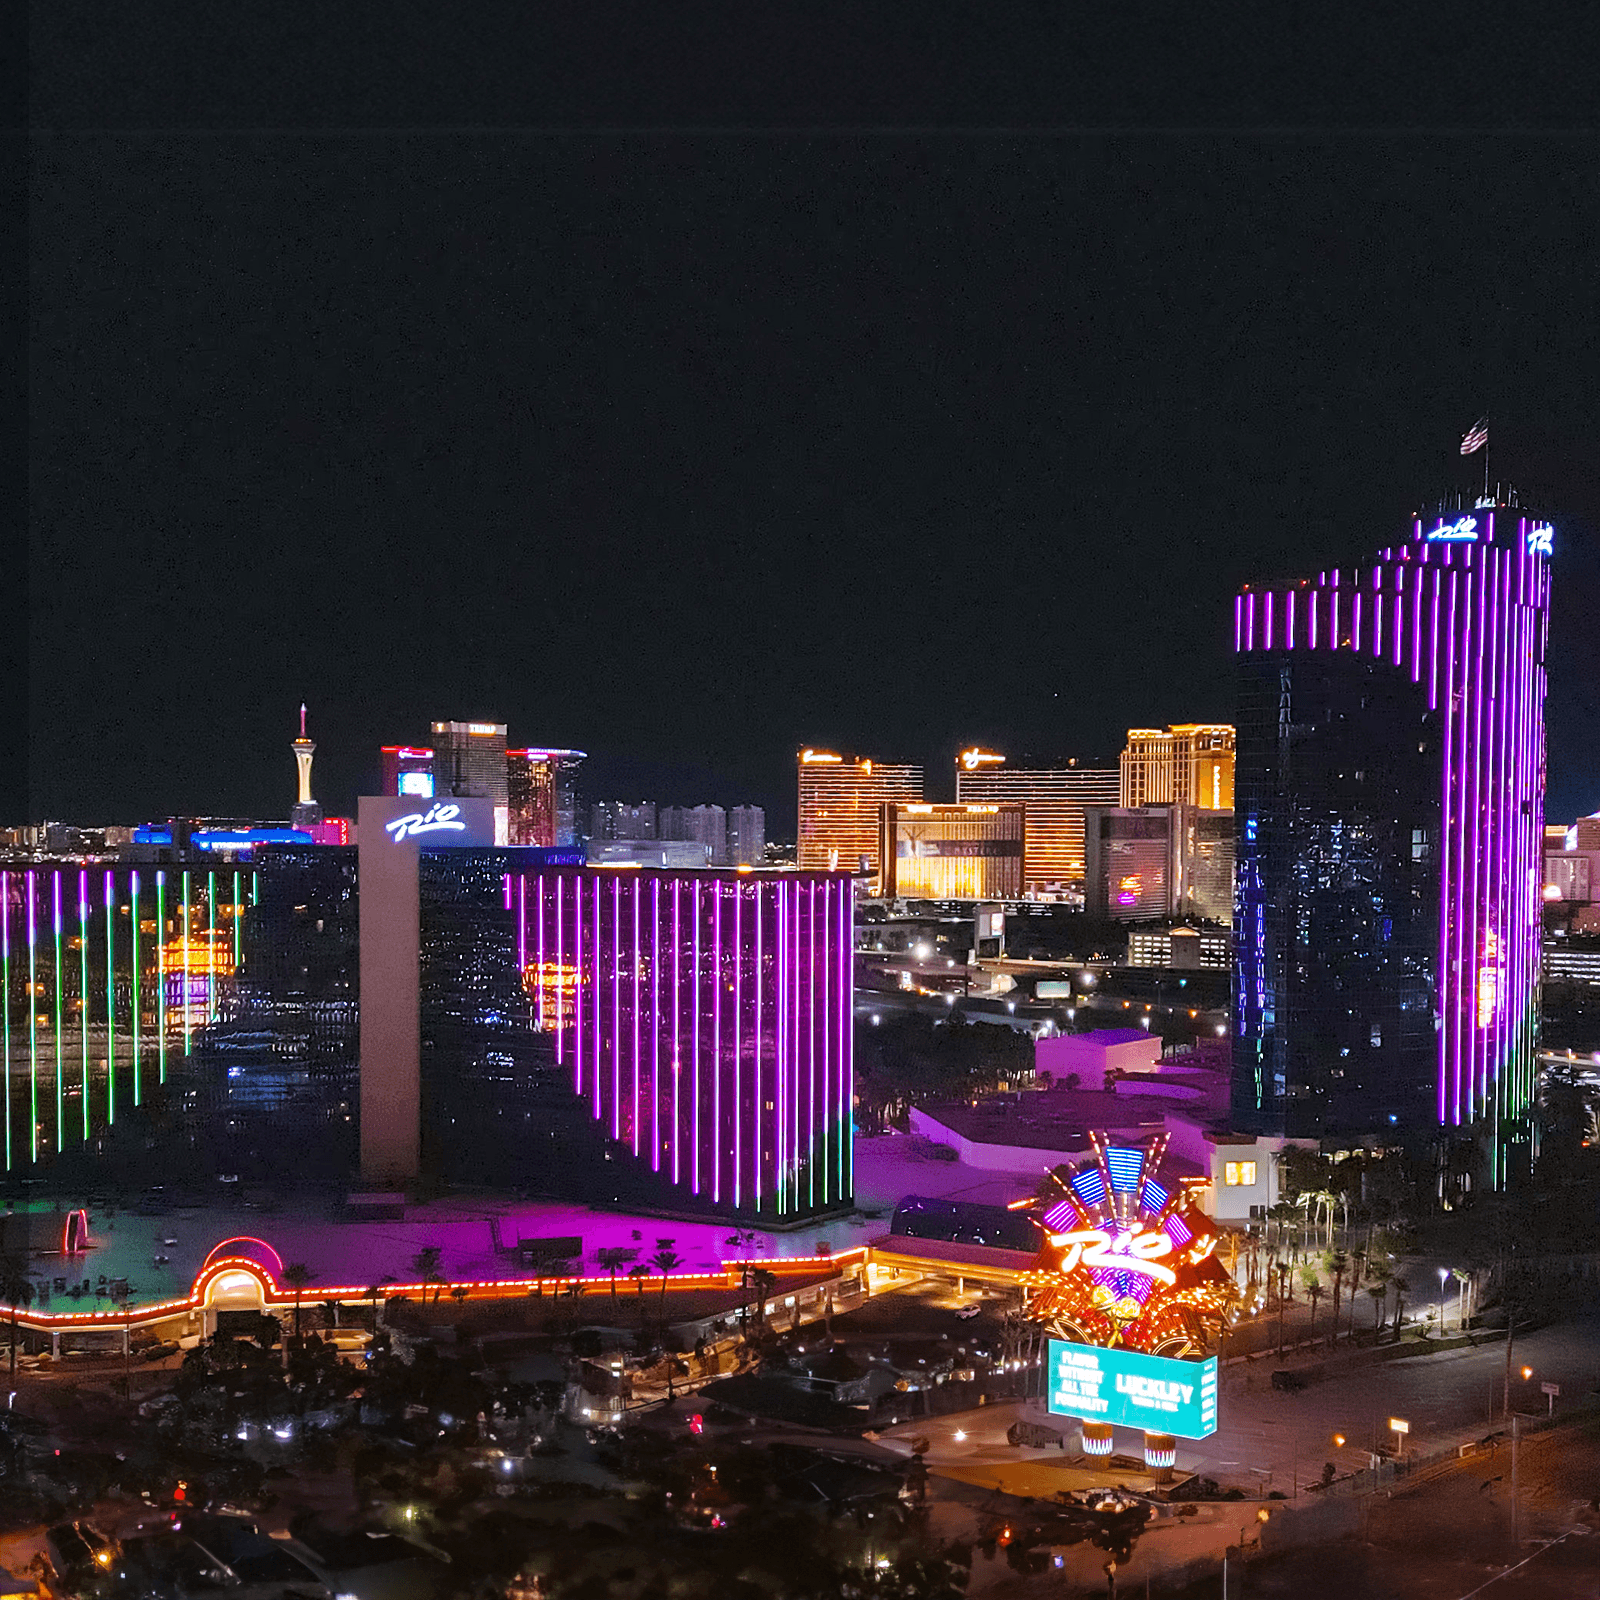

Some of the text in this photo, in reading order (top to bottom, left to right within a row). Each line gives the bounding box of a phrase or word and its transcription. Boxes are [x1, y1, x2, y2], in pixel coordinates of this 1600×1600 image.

[469, 723, 496, 734] TRUMP
[386, 803, 466, 843] Rio
[1050, 1221, 1177, 1287] Rio
[1061, 1379, 1079, 1394] ALL
[1116, 1373, 1194, 1404] LUCKLEY
